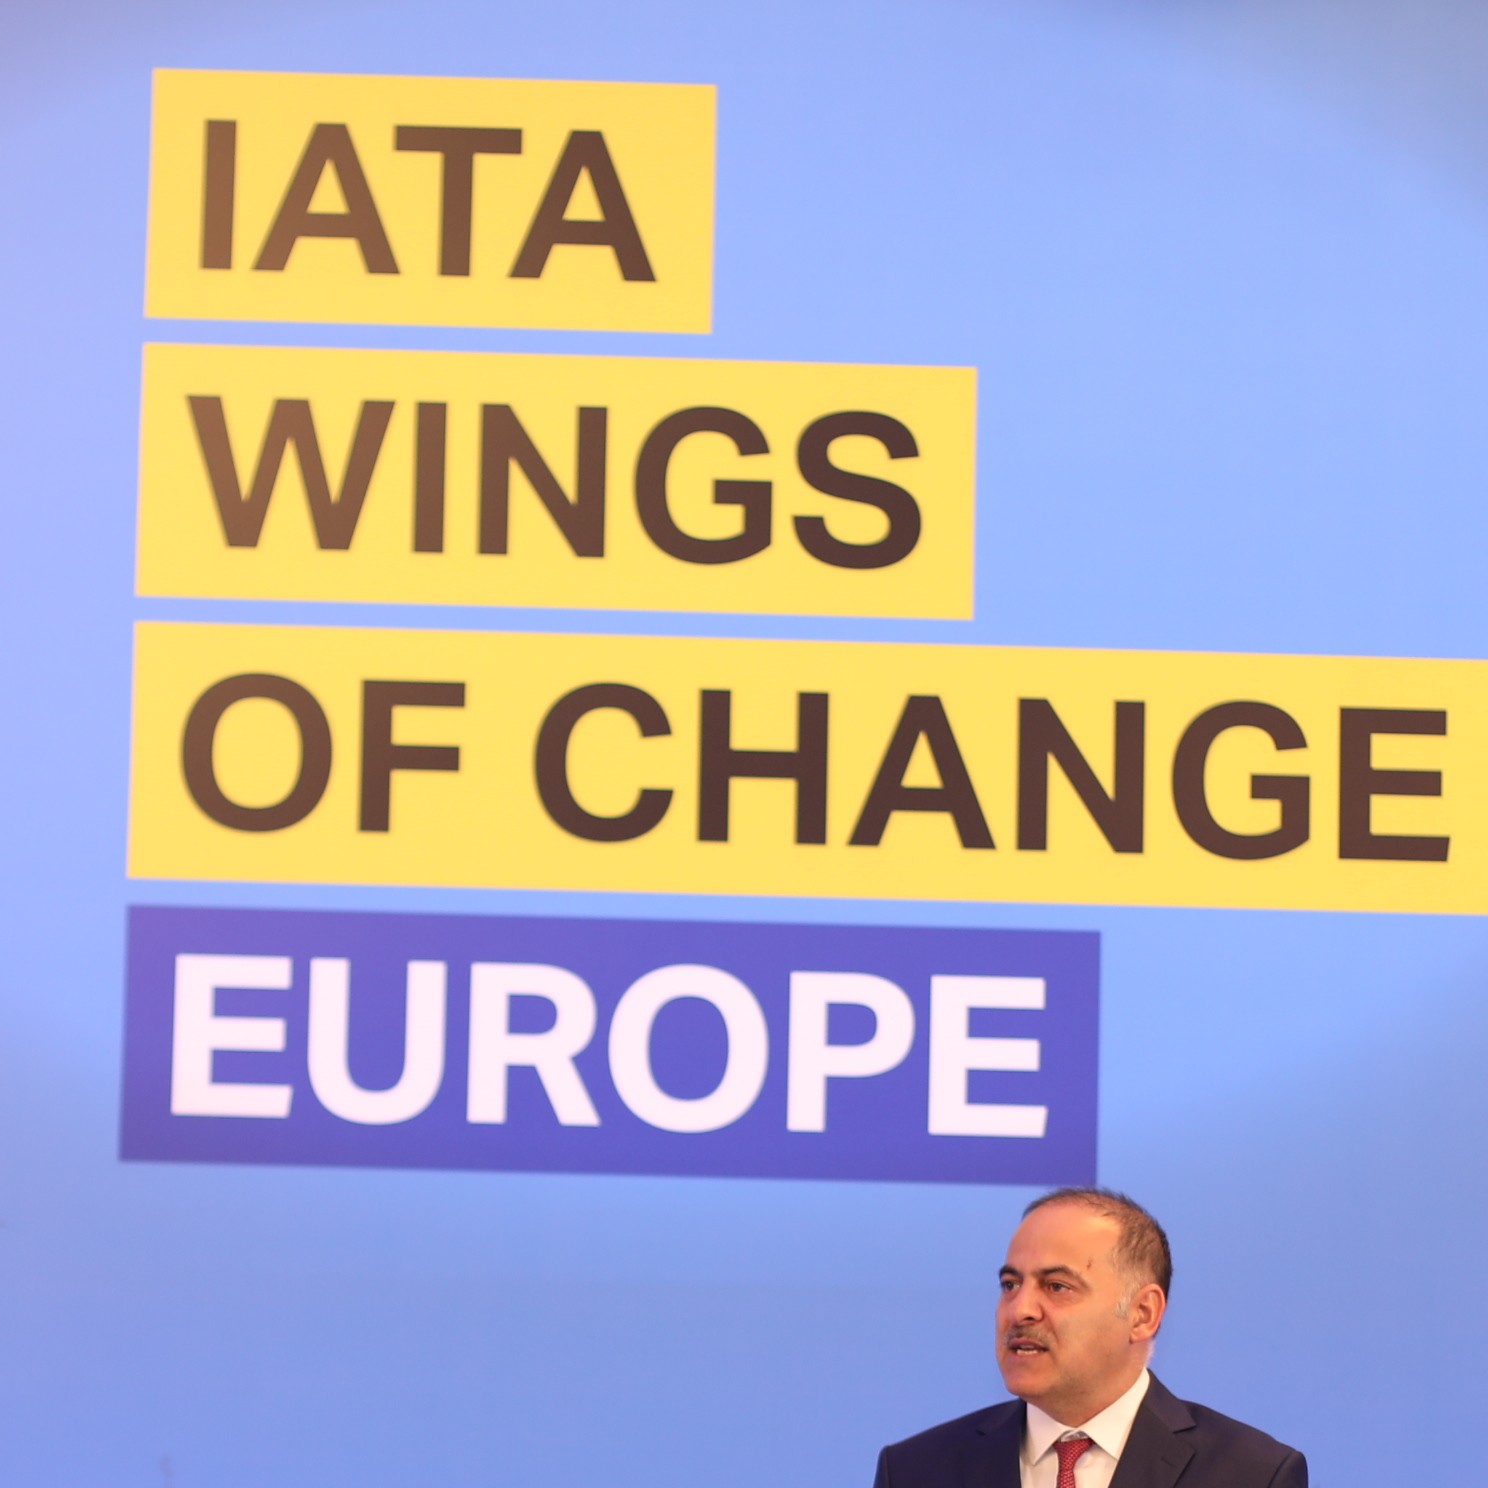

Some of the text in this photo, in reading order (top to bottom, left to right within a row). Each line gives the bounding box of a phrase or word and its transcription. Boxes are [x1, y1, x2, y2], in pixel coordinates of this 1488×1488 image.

[202, 120, 656, 282] IATA
[189, 396, 921, 569] WINGS
[182, 673, 1450, 862] OF CHANGE
[171, 954, 1047, 1137] EUROPE
